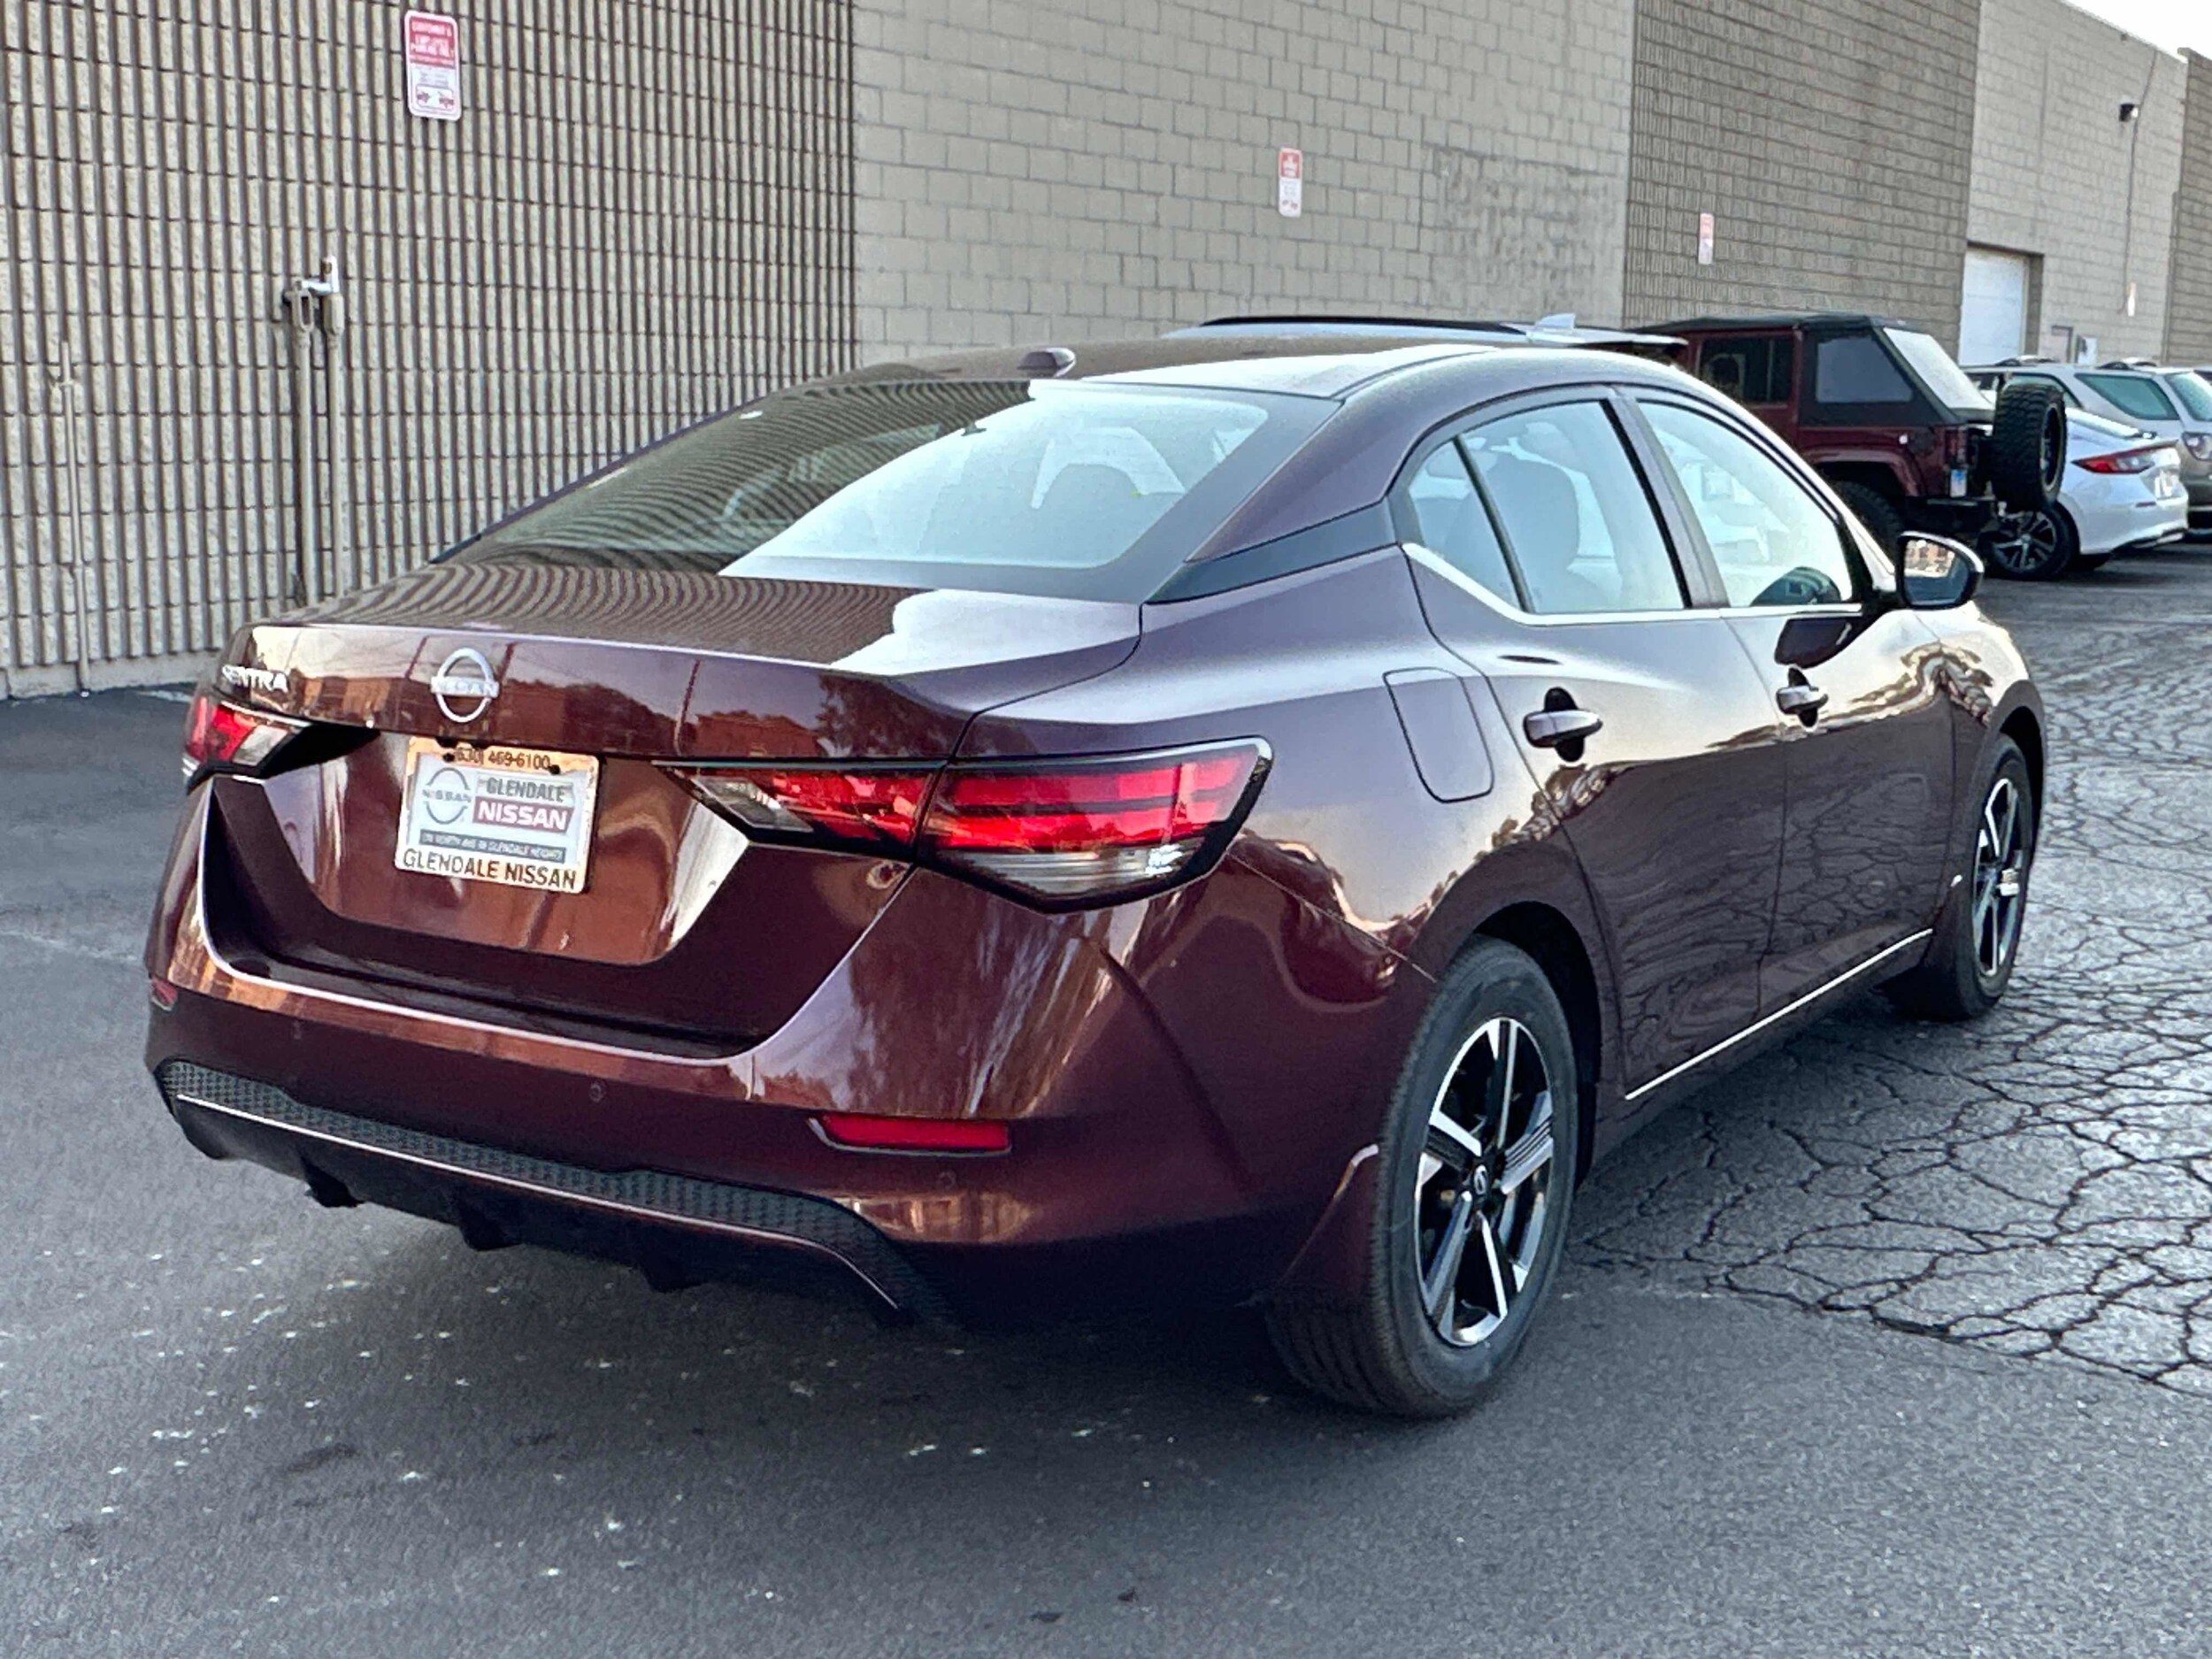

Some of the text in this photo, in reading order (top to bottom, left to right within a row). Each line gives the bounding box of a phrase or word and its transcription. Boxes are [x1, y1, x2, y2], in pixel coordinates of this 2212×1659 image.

[222, 664, 288, 693] SENTRA
[488, 751, 551, 769] 469-6100
[487, 777, 565, 803] GLENDALE
[478, 801, 568, 830] NISSAN
[403, 848, 577, 890] GLENDALE NISSAN
